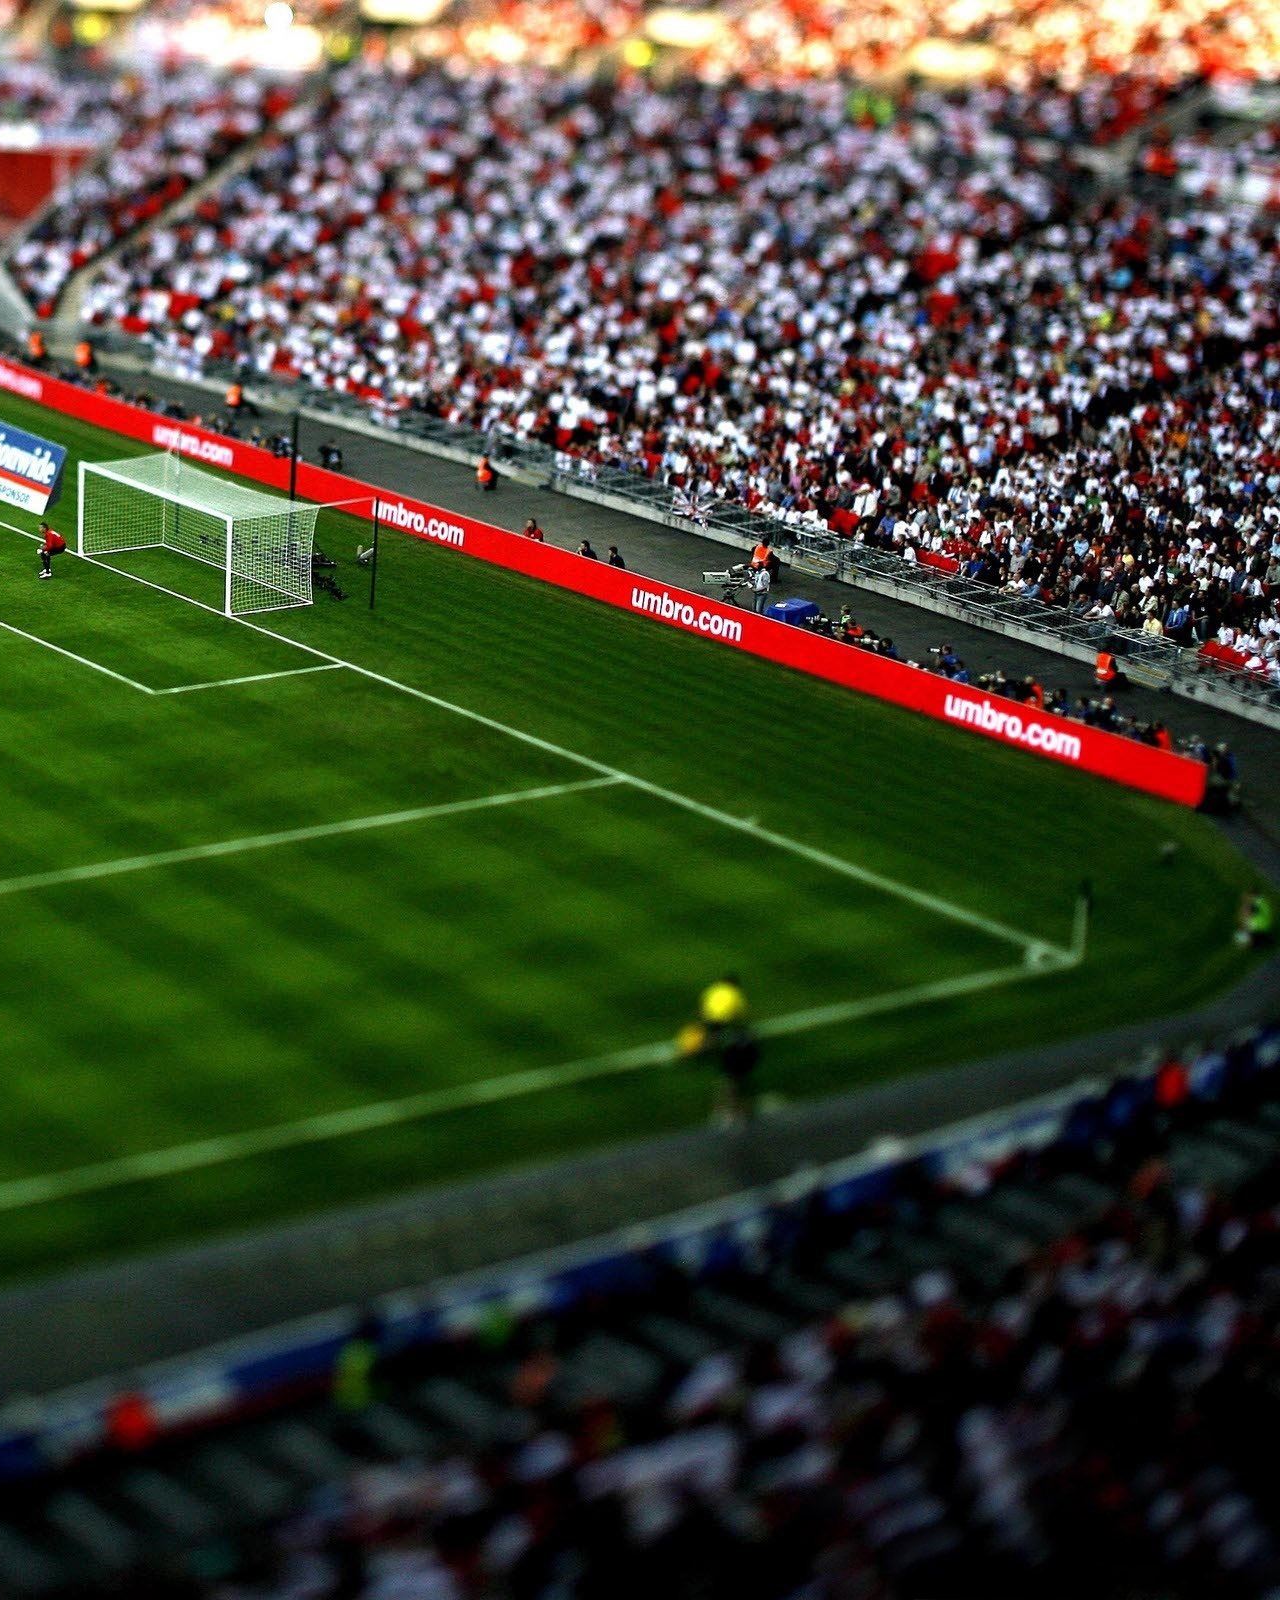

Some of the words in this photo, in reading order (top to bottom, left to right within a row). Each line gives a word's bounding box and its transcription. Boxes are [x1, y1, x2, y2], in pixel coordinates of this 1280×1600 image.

[153, 424, 234, 468] umbro.com
[371, 499, 465, 547] umbro.com
[631, 587, 742, 642] umbro.com
[944, 694, 1081, 760] umbro.com
